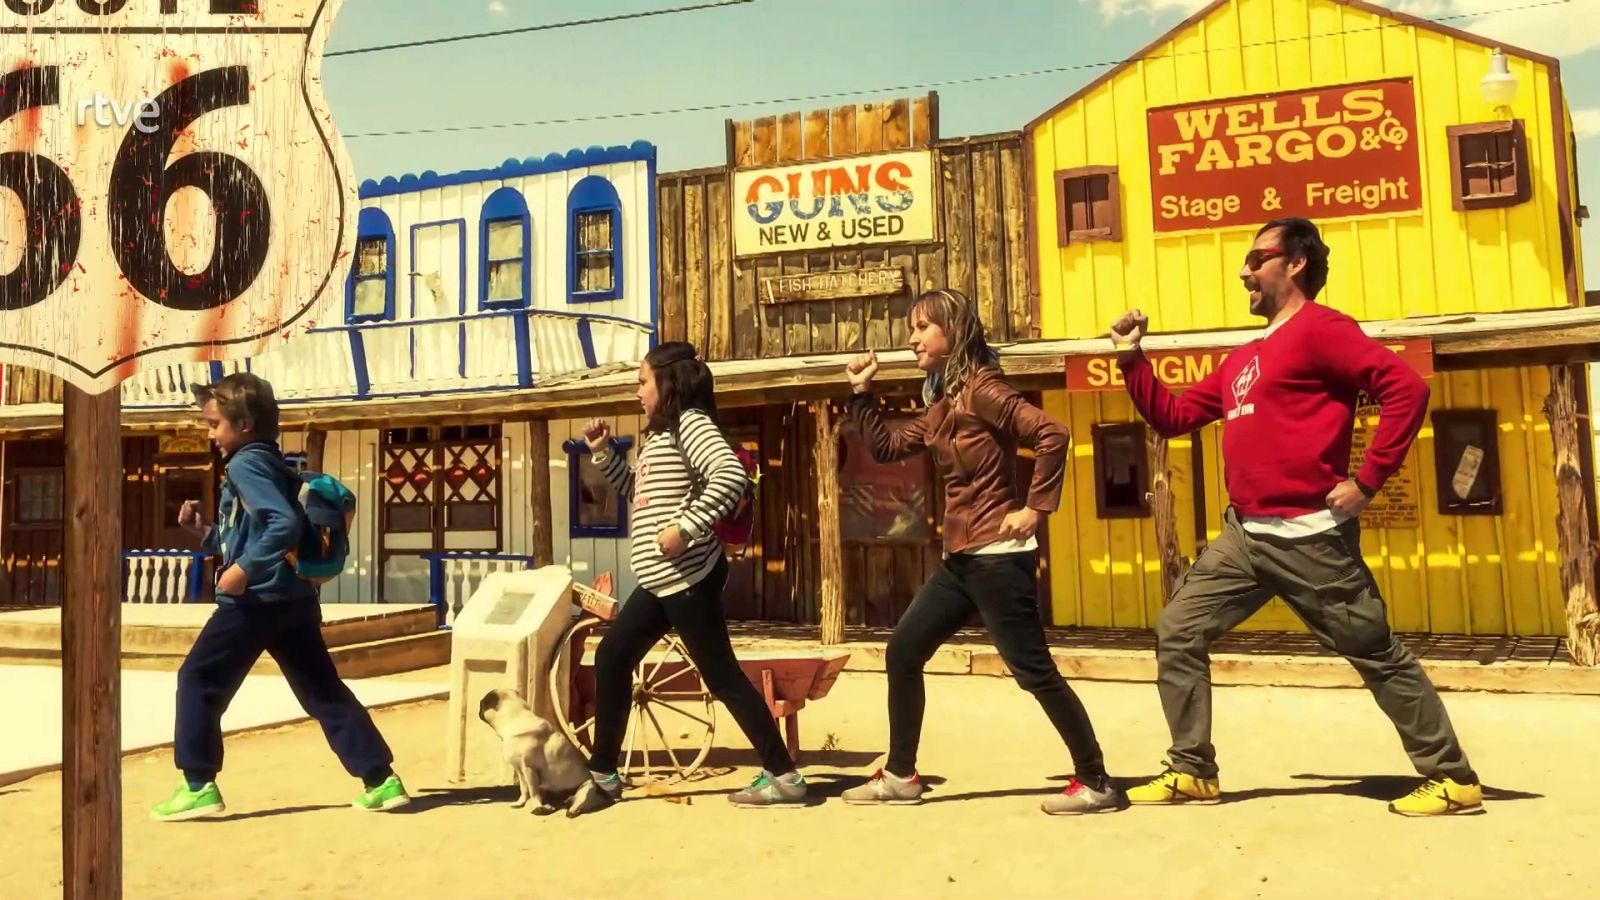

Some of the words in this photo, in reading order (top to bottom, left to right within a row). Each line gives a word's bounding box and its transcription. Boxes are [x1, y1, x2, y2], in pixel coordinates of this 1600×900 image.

[1174, 88, 1384, 141] WELLS
[0, 64, 271, 311] 66
[745, 161, 914, 225] GUNS
[1160, 194, 1241, 221] Stage
[1261, 187, 1282, 211] &
[1306, 176, 1409, 209] Freight
[759, 222, 809, 246] NEW
[816, 221, 831, 242] &
[841, 214, 904, 239] USED
[779, 277, 812, 293] FISH
